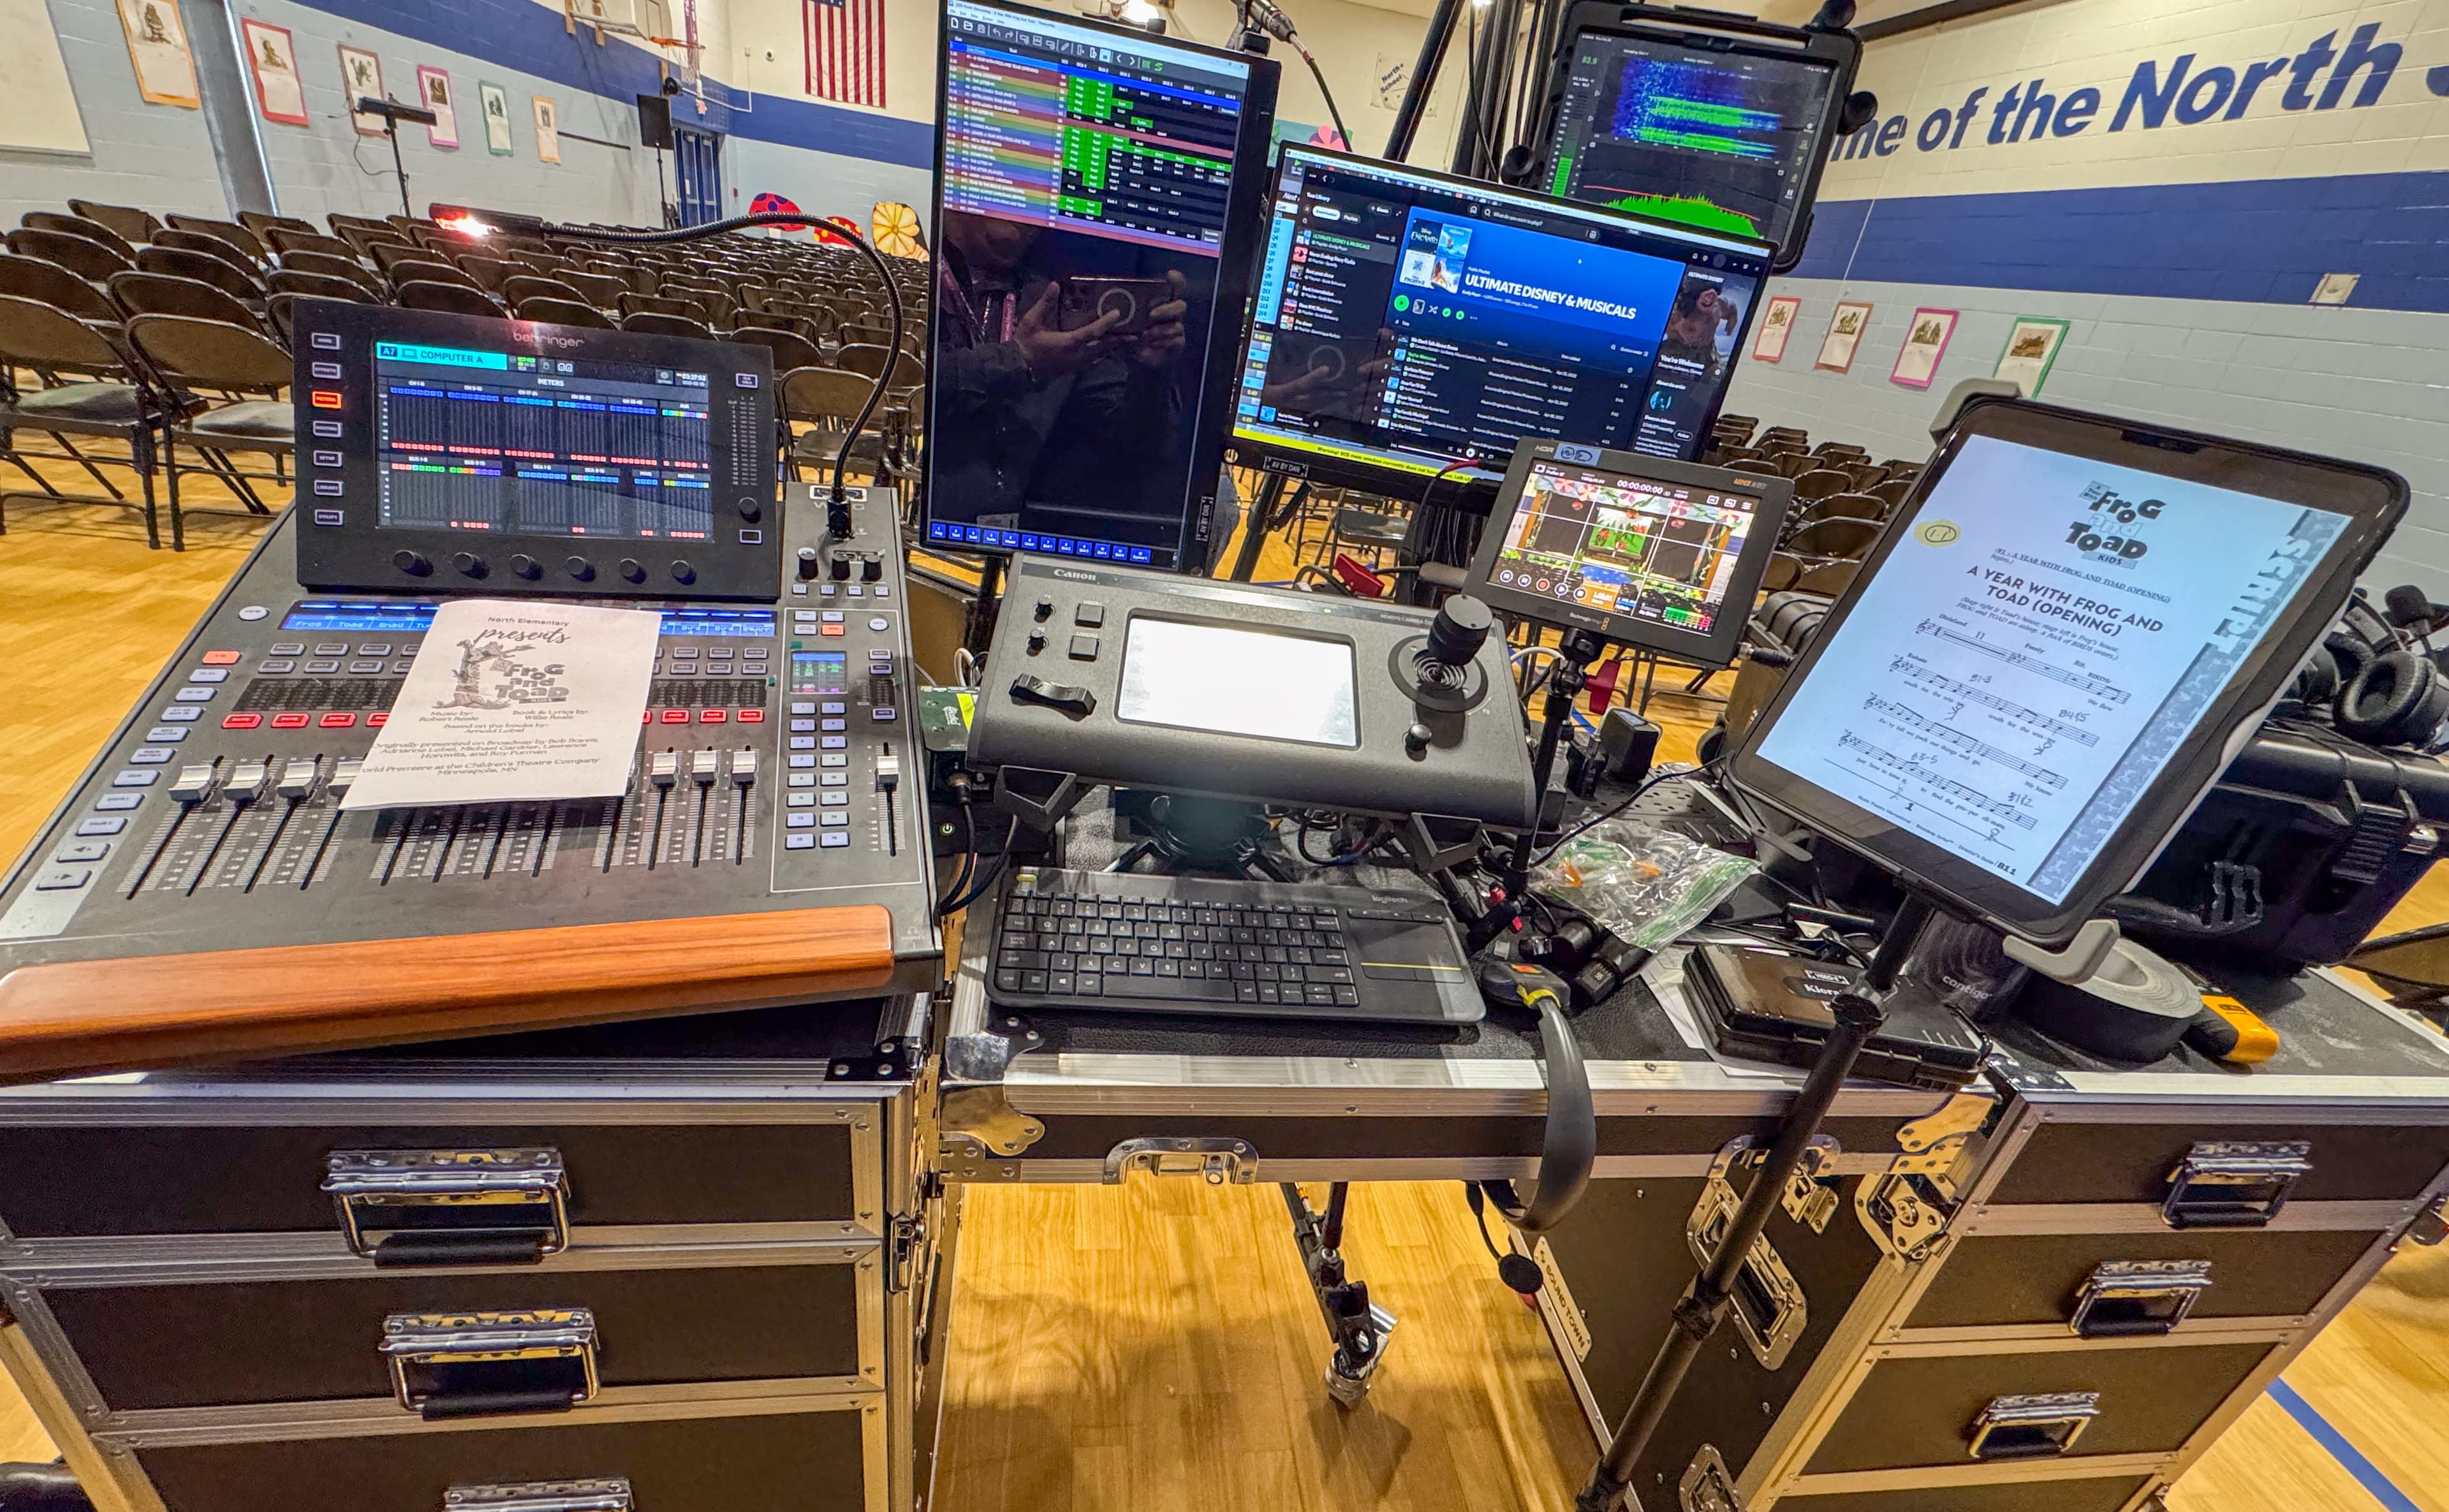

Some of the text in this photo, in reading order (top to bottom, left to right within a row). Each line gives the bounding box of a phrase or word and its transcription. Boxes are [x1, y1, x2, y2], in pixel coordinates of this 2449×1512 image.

[1381, 66, 1401, 83] North
[1381, 74, 1402, 93] School
[1916, 86, 1989, 152] of
[1988, 78, 2100, 145] the
[2108, 22, 2404, 132] North
[1464, 273, 1521, 297] ULTIMATE
[1522, 286, 1566, 305] DISNEY
[1566, 297, 1576, 307] &
[1575, 298, 1636, 319] MUSICALS
[513, 331, 584, 349] behringer
[383, 348, 483, 363] A7 COMPUTER A
[538, 378, 564, 386] METERS
[1271, 460, 1300, 473] AV BY DAN
[1617, 480, 1663, 495] 00:00:00:00
[2087, 513, 2144, 538] and
[2097, 554, 2123, 566] KIDS
[1054, 569, 1096, 581] Canon
[2019, 553, 2040, 566] YEAR
[2040, 559, 2061, 572] WITH
[2062, 565, 2083, 577] FROG
[2084, 573, 2102, 583] AND
[2103, 577, 2126, 591] TOAD
[2126, 585, 2171, 603] (OPENING)
[1966, 566, 2165, 632] A YEAR WITH FROG AND
[2208, 536, 2311, 654] SCRIPT
[1987, 585, 2123, 637] TOAD (OPENING)
[518, 618, 570, 627] Elementary
[1939, 613, 1968, 628] Dixieland
[1960, 597, 1978, 606] (Stage
[1978, 600, 1991, 610] right
[2000, 608, 2022, 620] Toad's
[2041, 621, 2059, 633] stage
[2059, 626, 2070, 636] left
[2077, 633, 2098, 646] Frog's
[472, 628, 572, 644] presents
[1956, 602, 1975, 612] FROG
[1975, 609, 1988, 617] and
[1988, 612, 2008, 624] TOAD
[2019, 622, 2038, 634] asleep.
[2047, 632, 2063, 642] flock
[2070, 639, 2094, 652] BIRDS
[2094, 647, 2119, 661] enters.)
[2024, 643, 2046, 654] Freely
[1906, 652, 1928, 663] Rubato
[509, 677, 555, 687] and
[1032, 680, 1043, 689] W
[2087, 672, 2112, 684] BIRDS:
[554, 757, 600, 765] Company
[1997, 862, 2017, 876] B11
[1371, 895, 1409, 905] logitech
[1943, 976, 1990, 1000] contigo
[1546, 1265, 1584, 1348] SOUND TOWN
